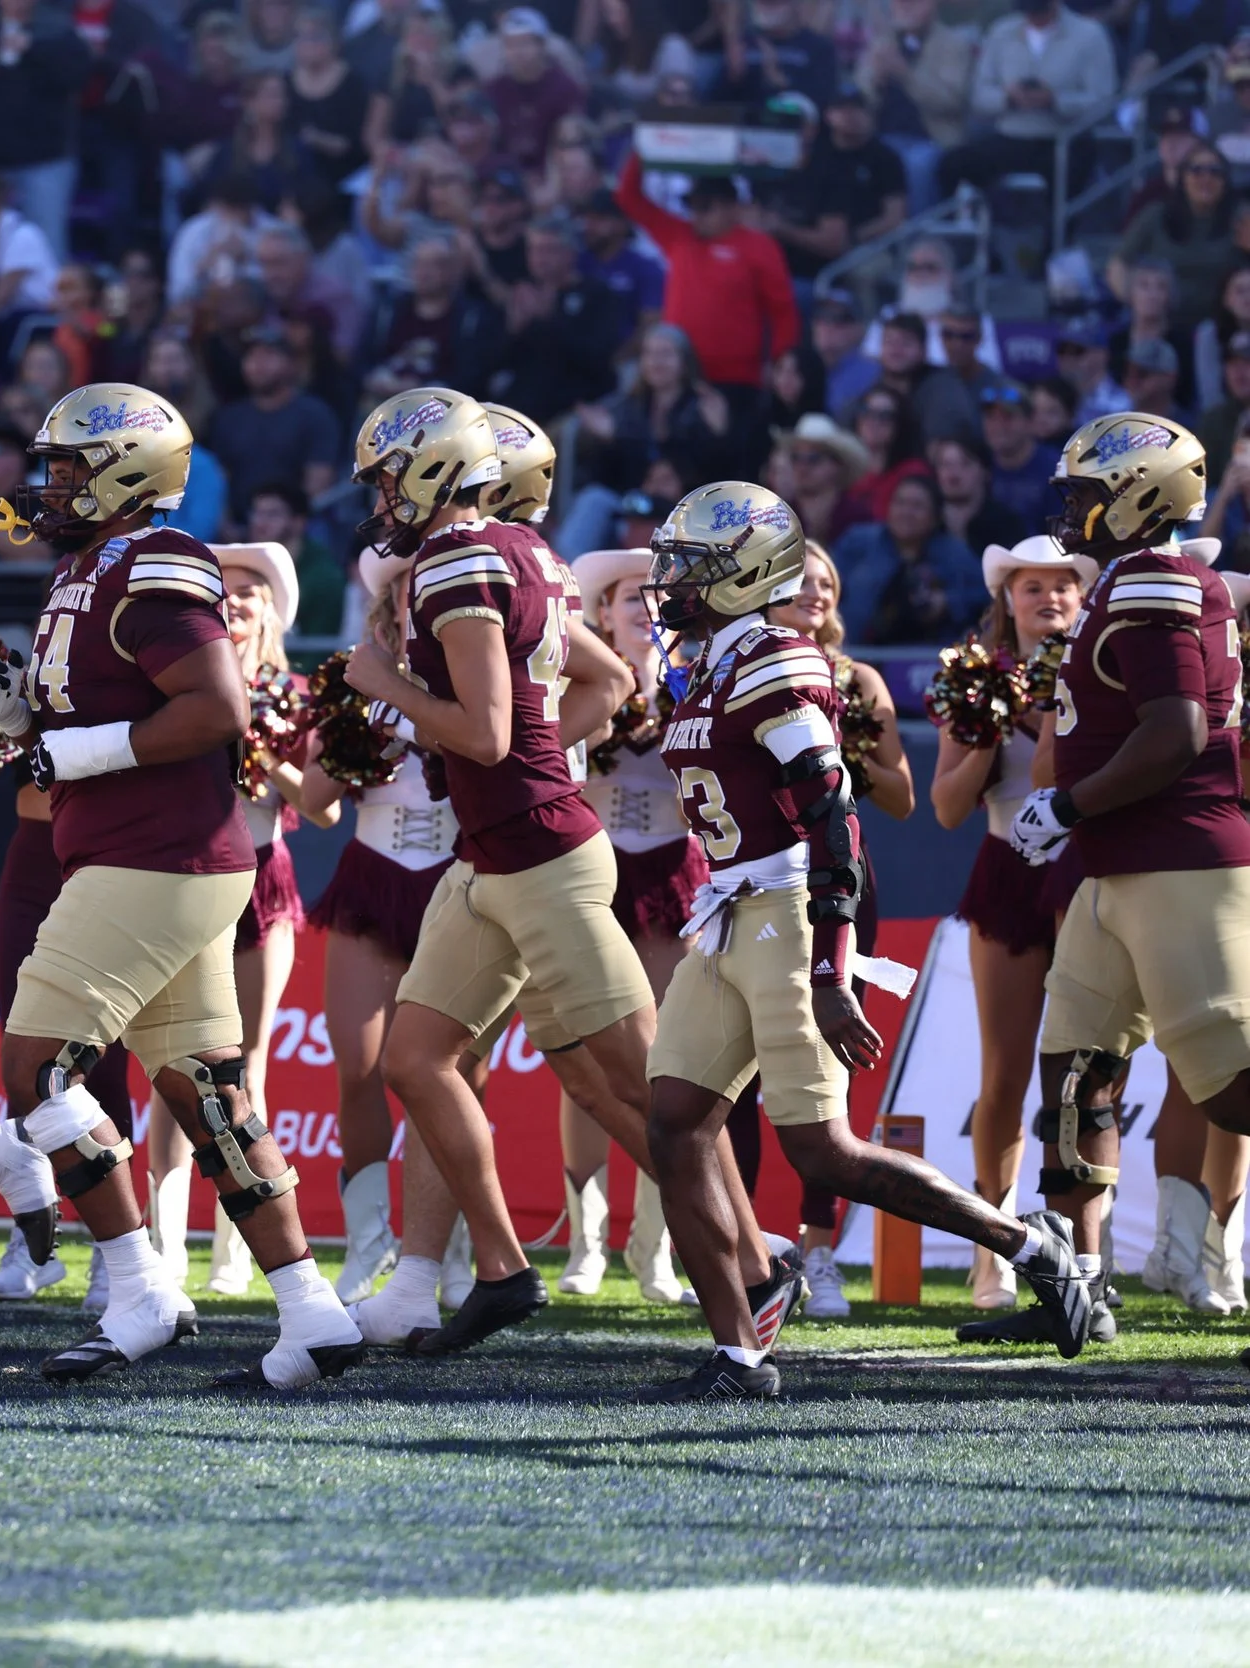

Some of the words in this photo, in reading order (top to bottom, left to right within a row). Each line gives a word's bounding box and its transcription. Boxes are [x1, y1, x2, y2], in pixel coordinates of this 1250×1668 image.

[86, 402, 166, 436] Bobcats
[372, 399, 447, 455] Bobcats
[1096, 424, 1171, 465] Bobcats
[710, 499, 790, 533] Bobcats
[670, 766, 741, 860] 3
